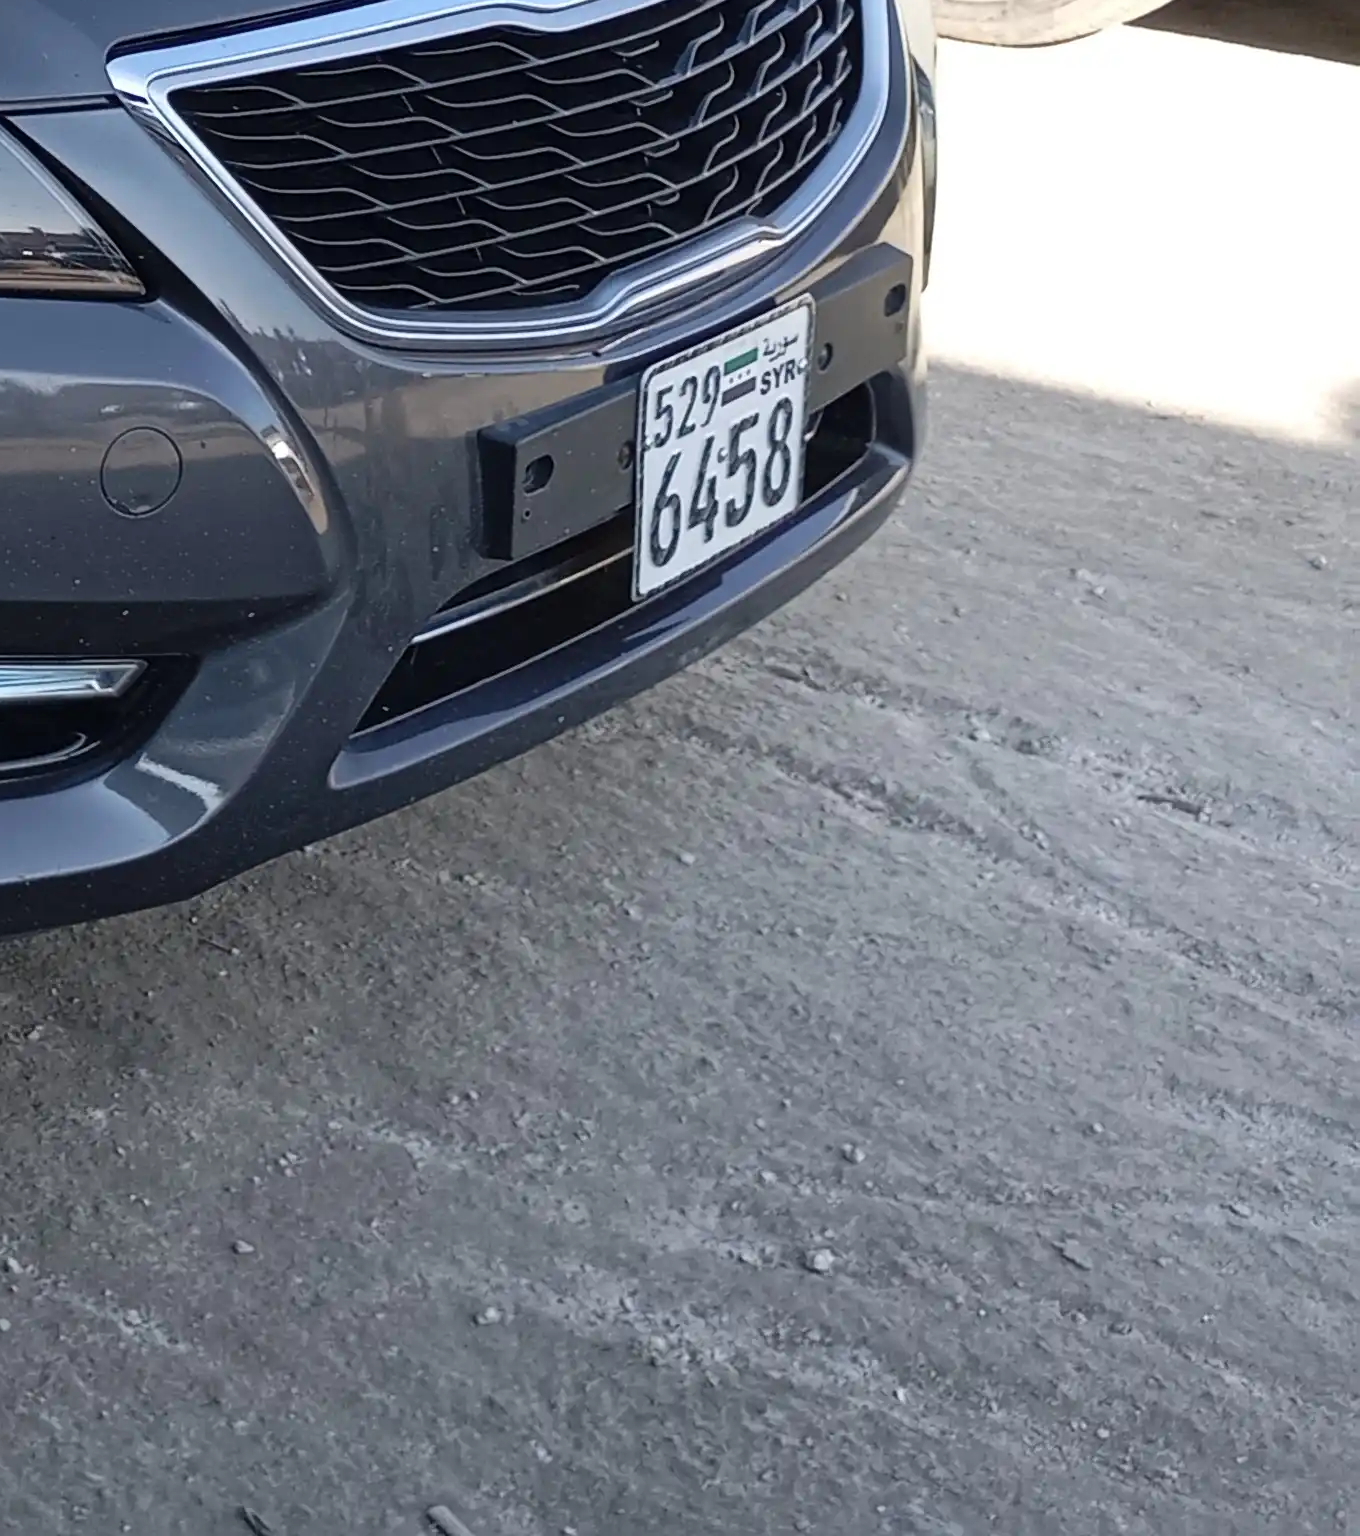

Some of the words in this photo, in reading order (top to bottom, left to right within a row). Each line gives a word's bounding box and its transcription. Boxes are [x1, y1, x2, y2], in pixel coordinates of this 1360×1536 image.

[654, 365, 721, 448] 529
[759, 359, 796, 395] SYR
[649, 396, 794, 567] 6458
